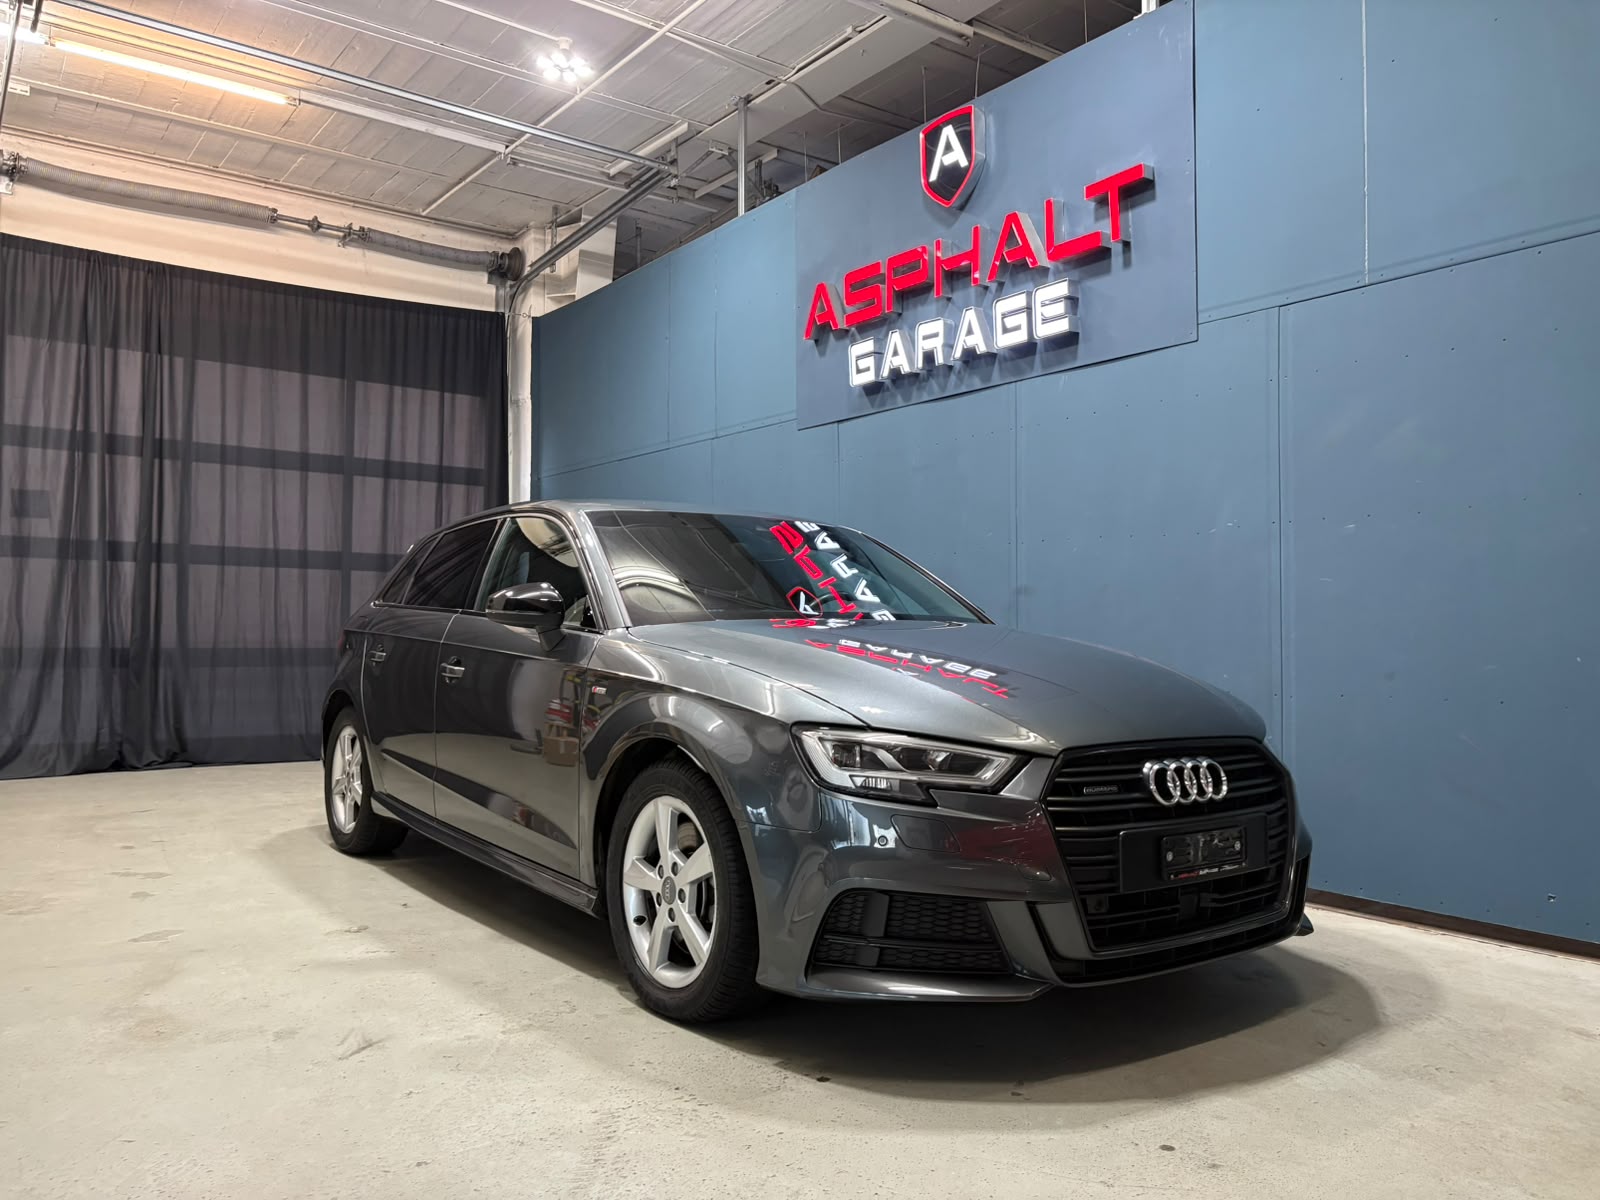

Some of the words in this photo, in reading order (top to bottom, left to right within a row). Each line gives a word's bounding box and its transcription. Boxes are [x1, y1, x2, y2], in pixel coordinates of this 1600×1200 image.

[929, 124, 969, 182] A
[803, 162, 1145, 340] ASPHALT
[848, 277, 1070, 388] GARAGE
